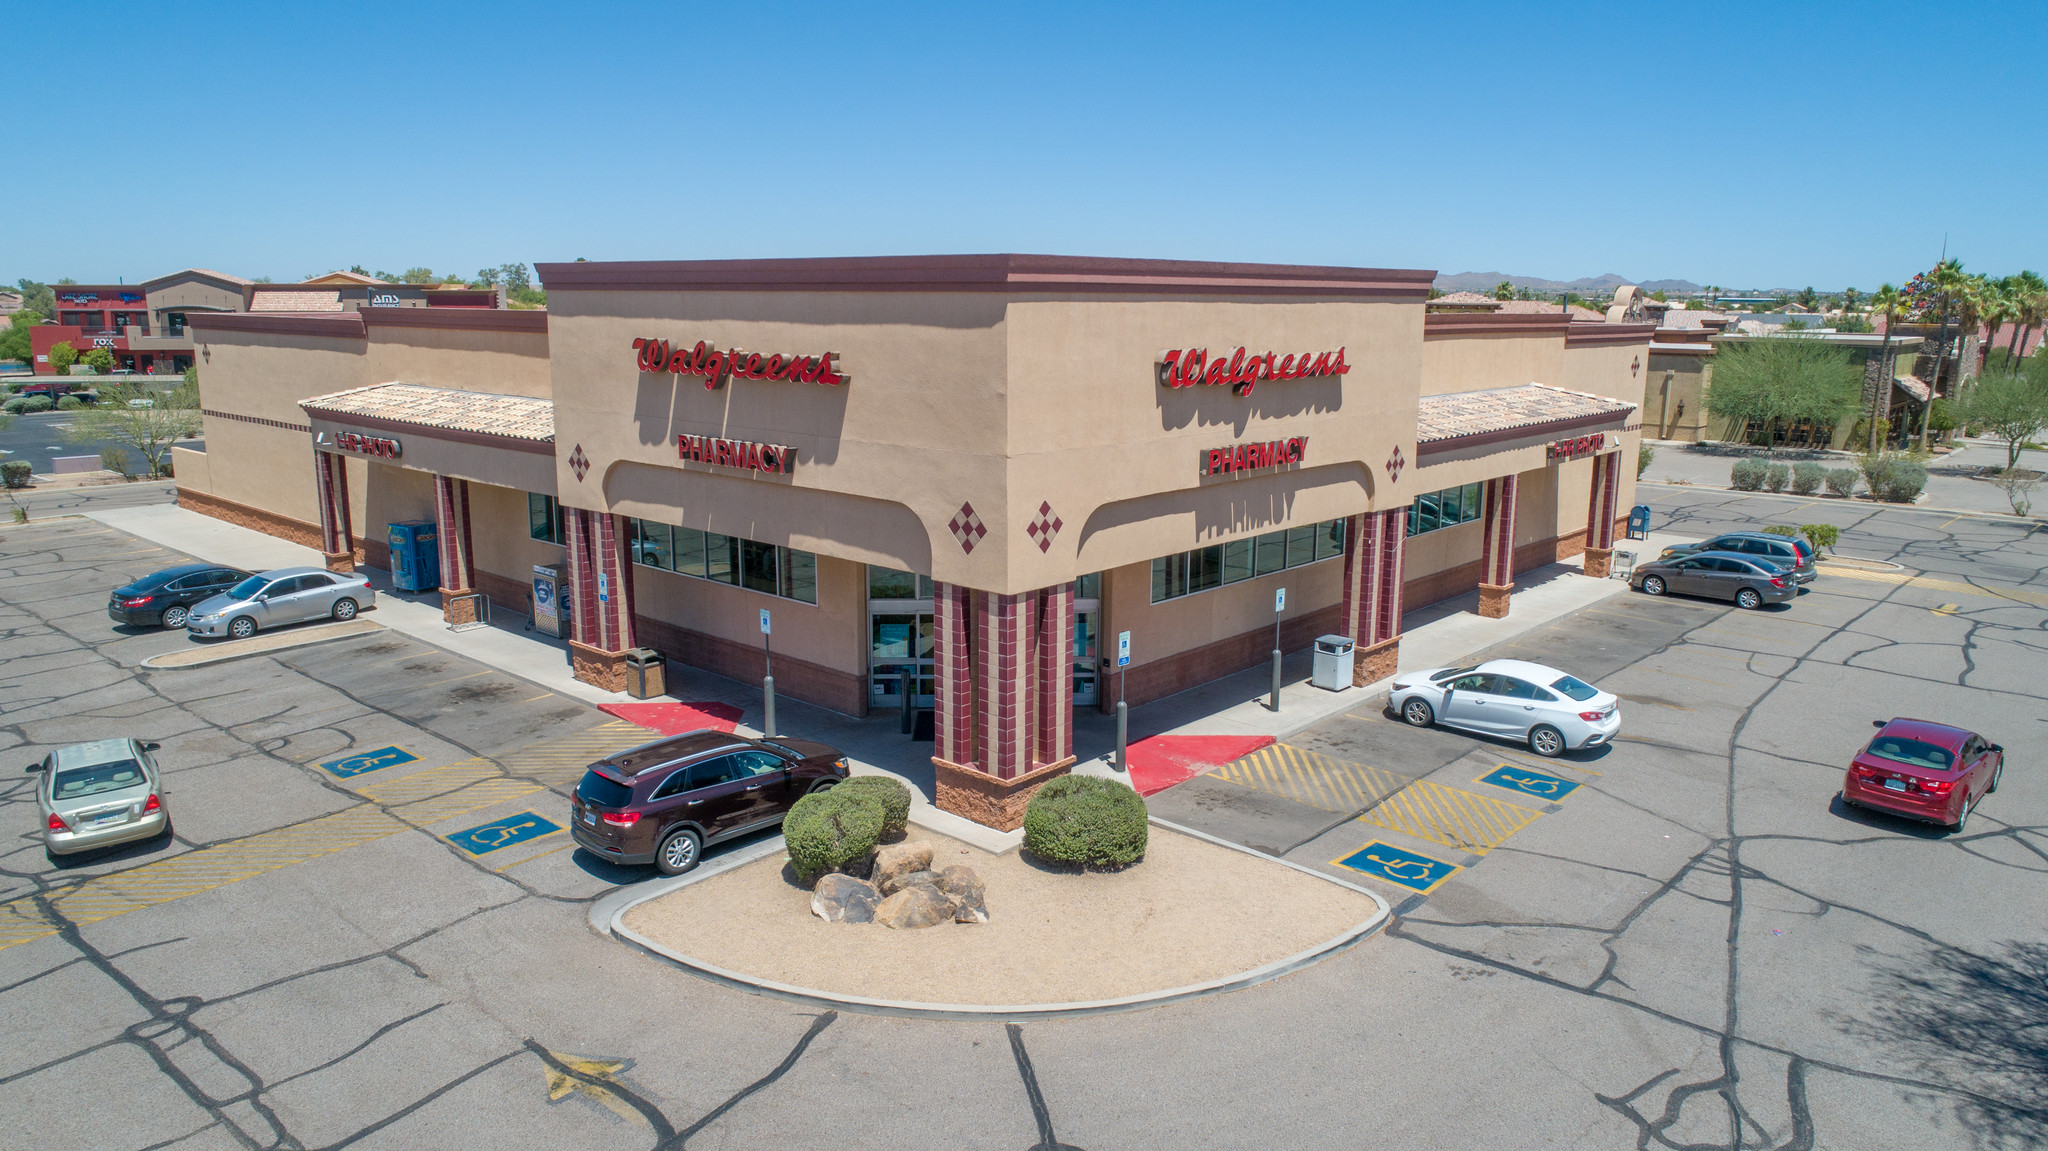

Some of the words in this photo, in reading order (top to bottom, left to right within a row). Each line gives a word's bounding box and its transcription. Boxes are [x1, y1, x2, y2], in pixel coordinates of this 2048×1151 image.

[373, 294, 400, 303] AMS
[632, 337, 843, 391] Walgreens
[1163, 346, 1351, 397] Walgreens
[335, 431, 358, 452] 1-HR
[361, 435, 395, 459] PHOTO
[678, 434, 788, 475] PHARMACY
[1209, 436, 1309, 476] PHARMACY
[1554, 439, 1575, 459] 1-HR
[1577, 433, 1605, 455] PHOTO
